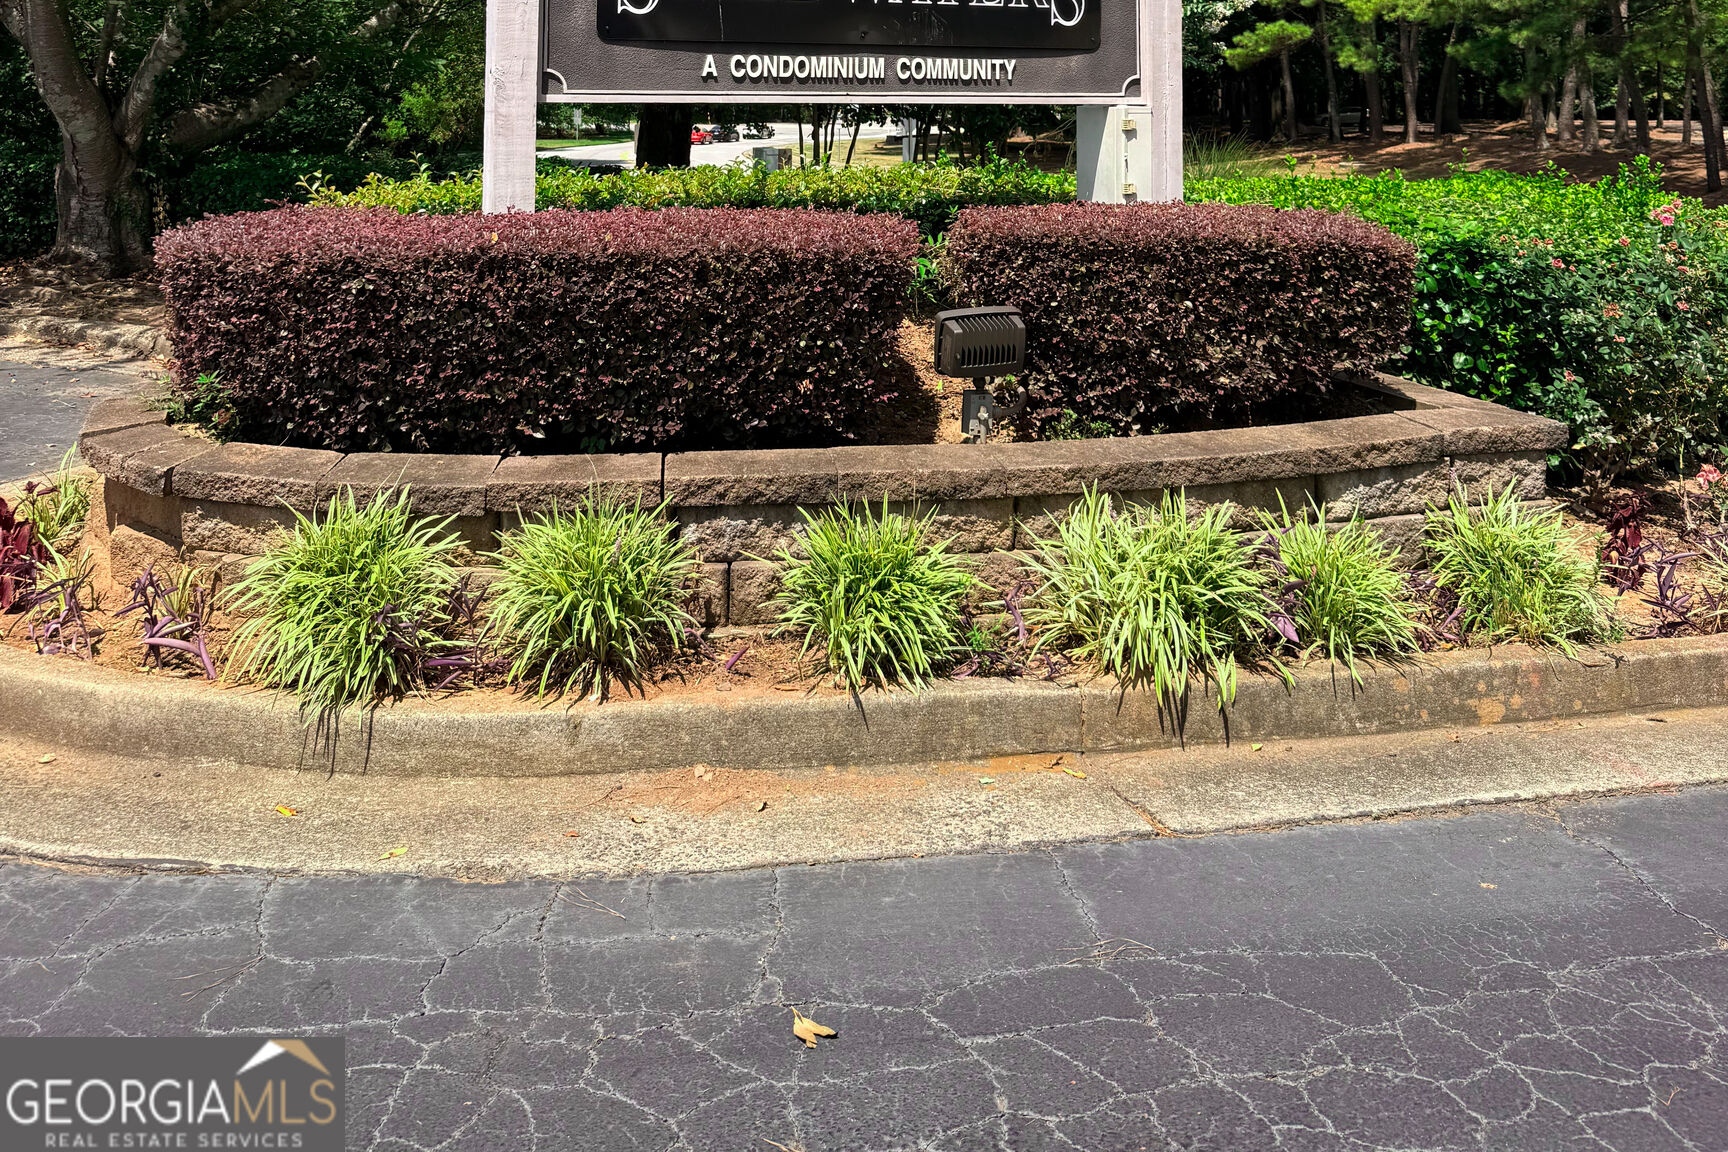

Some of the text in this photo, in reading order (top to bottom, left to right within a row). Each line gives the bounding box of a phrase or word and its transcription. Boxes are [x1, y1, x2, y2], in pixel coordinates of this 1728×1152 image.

[701, 54, 1017, 81] A CONDOMINIUM COMMUNITY
